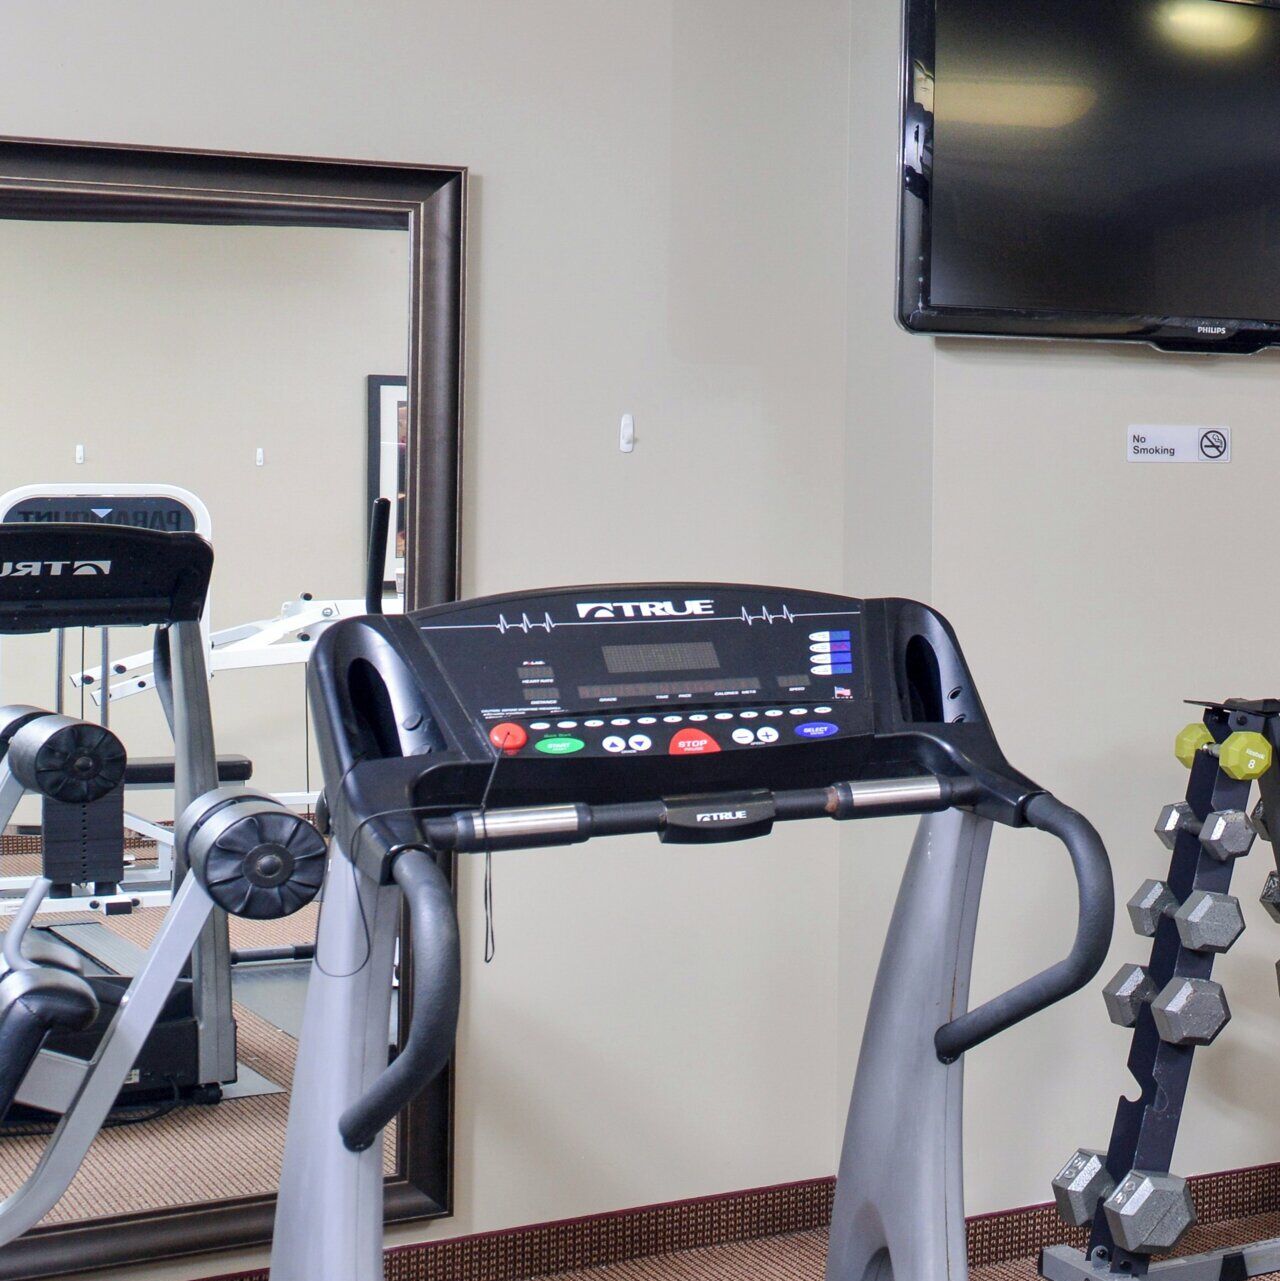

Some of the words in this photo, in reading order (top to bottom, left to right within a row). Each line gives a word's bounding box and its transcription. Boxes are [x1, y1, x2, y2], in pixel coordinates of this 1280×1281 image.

[1198, 326, 1226, 335] PHILIPS
[1132, 435, 1146, 443] No
[1133, 446, 1175, 456] Smoking
[612, 600, 715, 618] TRUE
[1248, 759, 1255, 769] 8
[712, 811, 747, 821] TRUE
